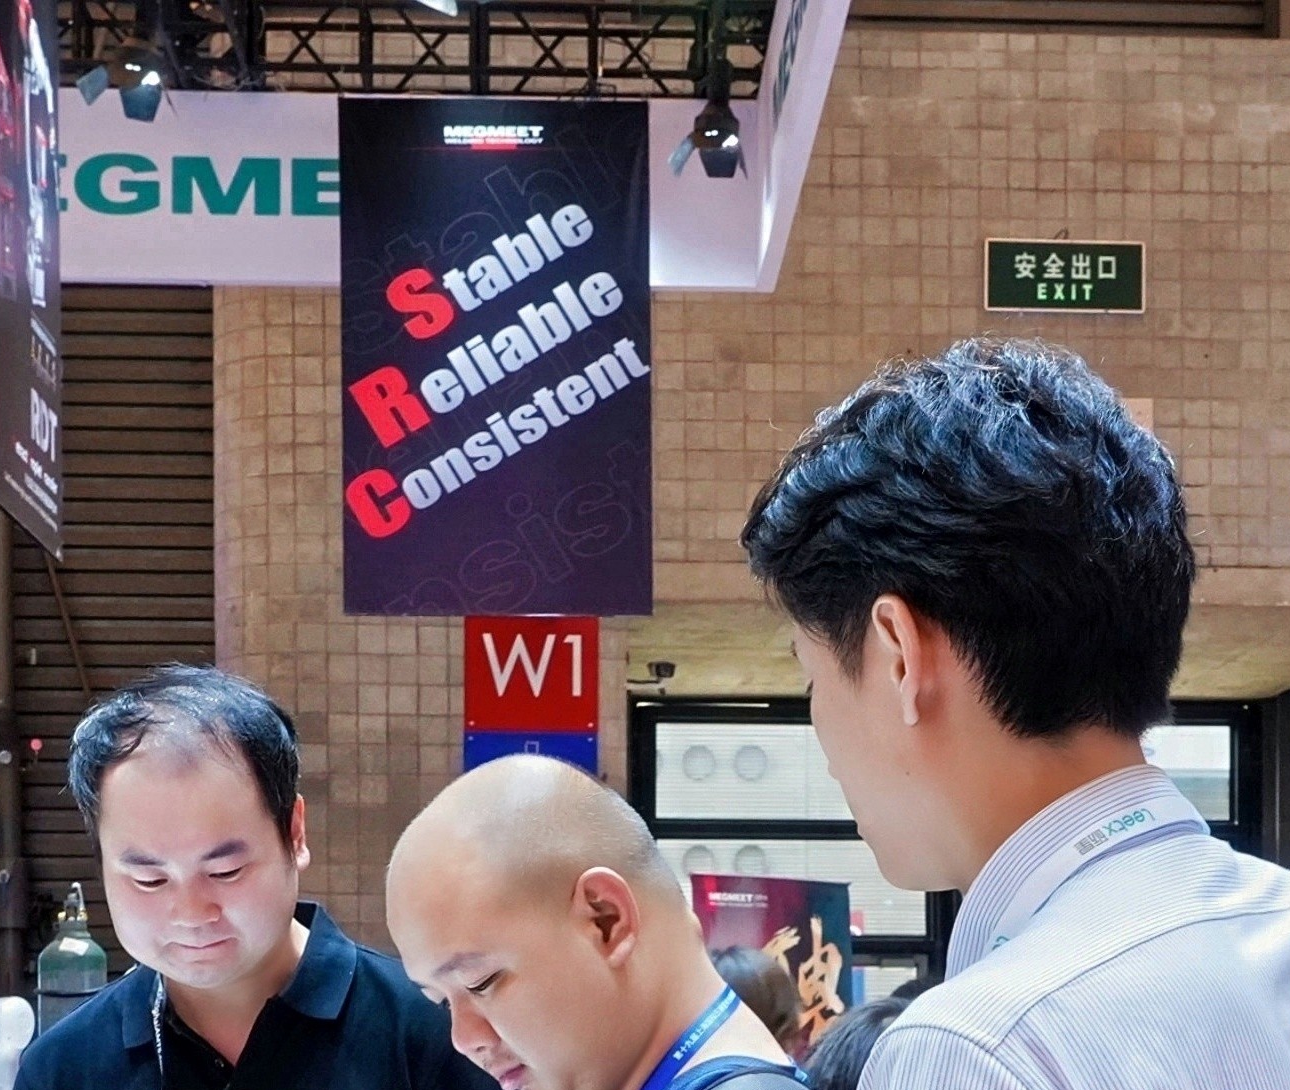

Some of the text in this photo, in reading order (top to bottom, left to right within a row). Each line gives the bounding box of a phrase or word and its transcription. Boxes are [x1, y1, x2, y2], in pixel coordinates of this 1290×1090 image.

[386, 204, 594, 340] Stable
[1014, 252, 1117, 280] 安全出口
[1037, 283, 1093, 300] EXIT
[350, 271, 624, 448] Reliable
[346, 337, 650, 538] Consistent
[482, 632, 583, 698] W1
